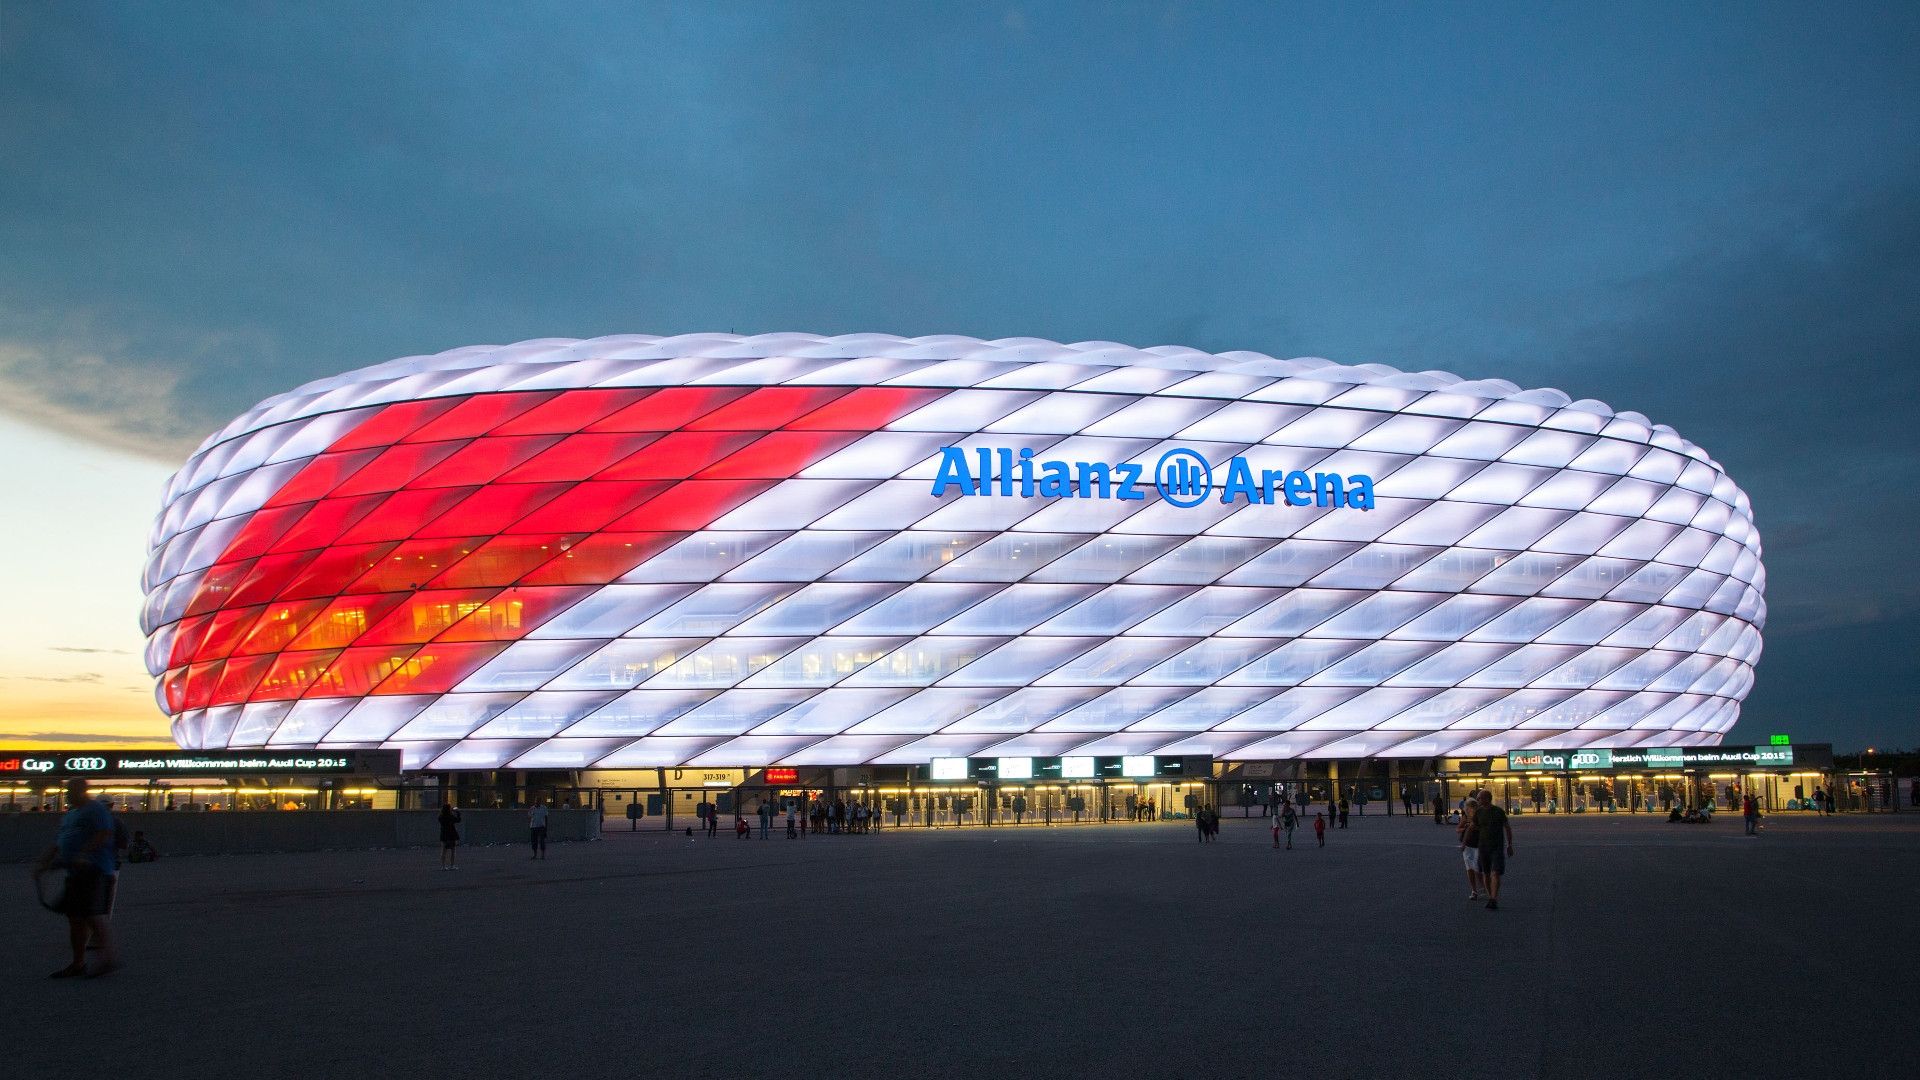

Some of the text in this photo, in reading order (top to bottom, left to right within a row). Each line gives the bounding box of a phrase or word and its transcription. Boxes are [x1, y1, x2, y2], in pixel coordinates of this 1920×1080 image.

[931, 447, 1376, 510] Allianz Arena
[1514, 755, 1564, 769] Audi Cup
[1608, 752, 1786, 763] Herzlich Willkommen beim Audi Cup 2015
[22, 758, 54, 772] Cup
[118, 758, 347, 769] Herzlich Willkommen beim Audi Cup 2015
[674, 769, 683, 780] D
[703, 773, 726, 781] 317-319
